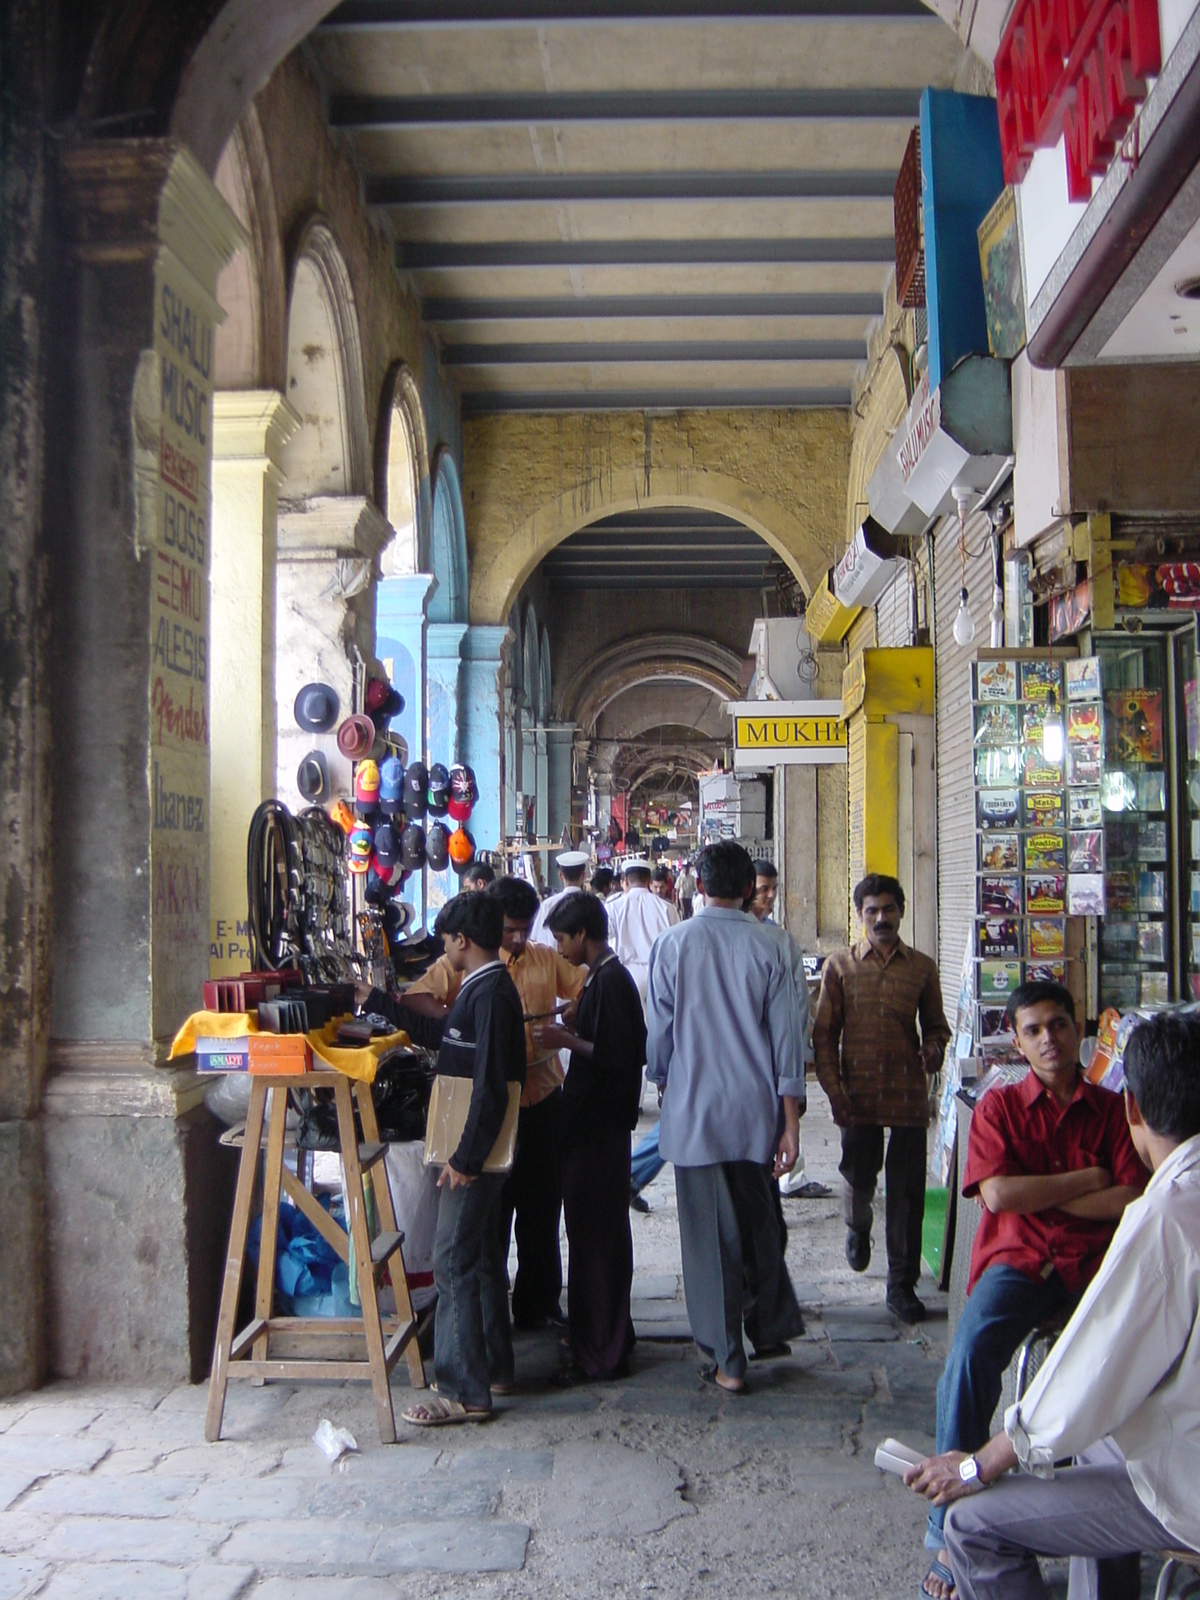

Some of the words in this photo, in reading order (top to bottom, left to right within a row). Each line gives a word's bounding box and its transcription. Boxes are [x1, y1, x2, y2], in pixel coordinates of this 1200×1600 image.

[161, 284, 212, 381] SHALU
[161, 356, 208, 446] MUSIC
[164, 492, 204, 566] BOSS
[153, 761, 204, 832] Ibanez
[154, 859, 200, 915] AKAI
